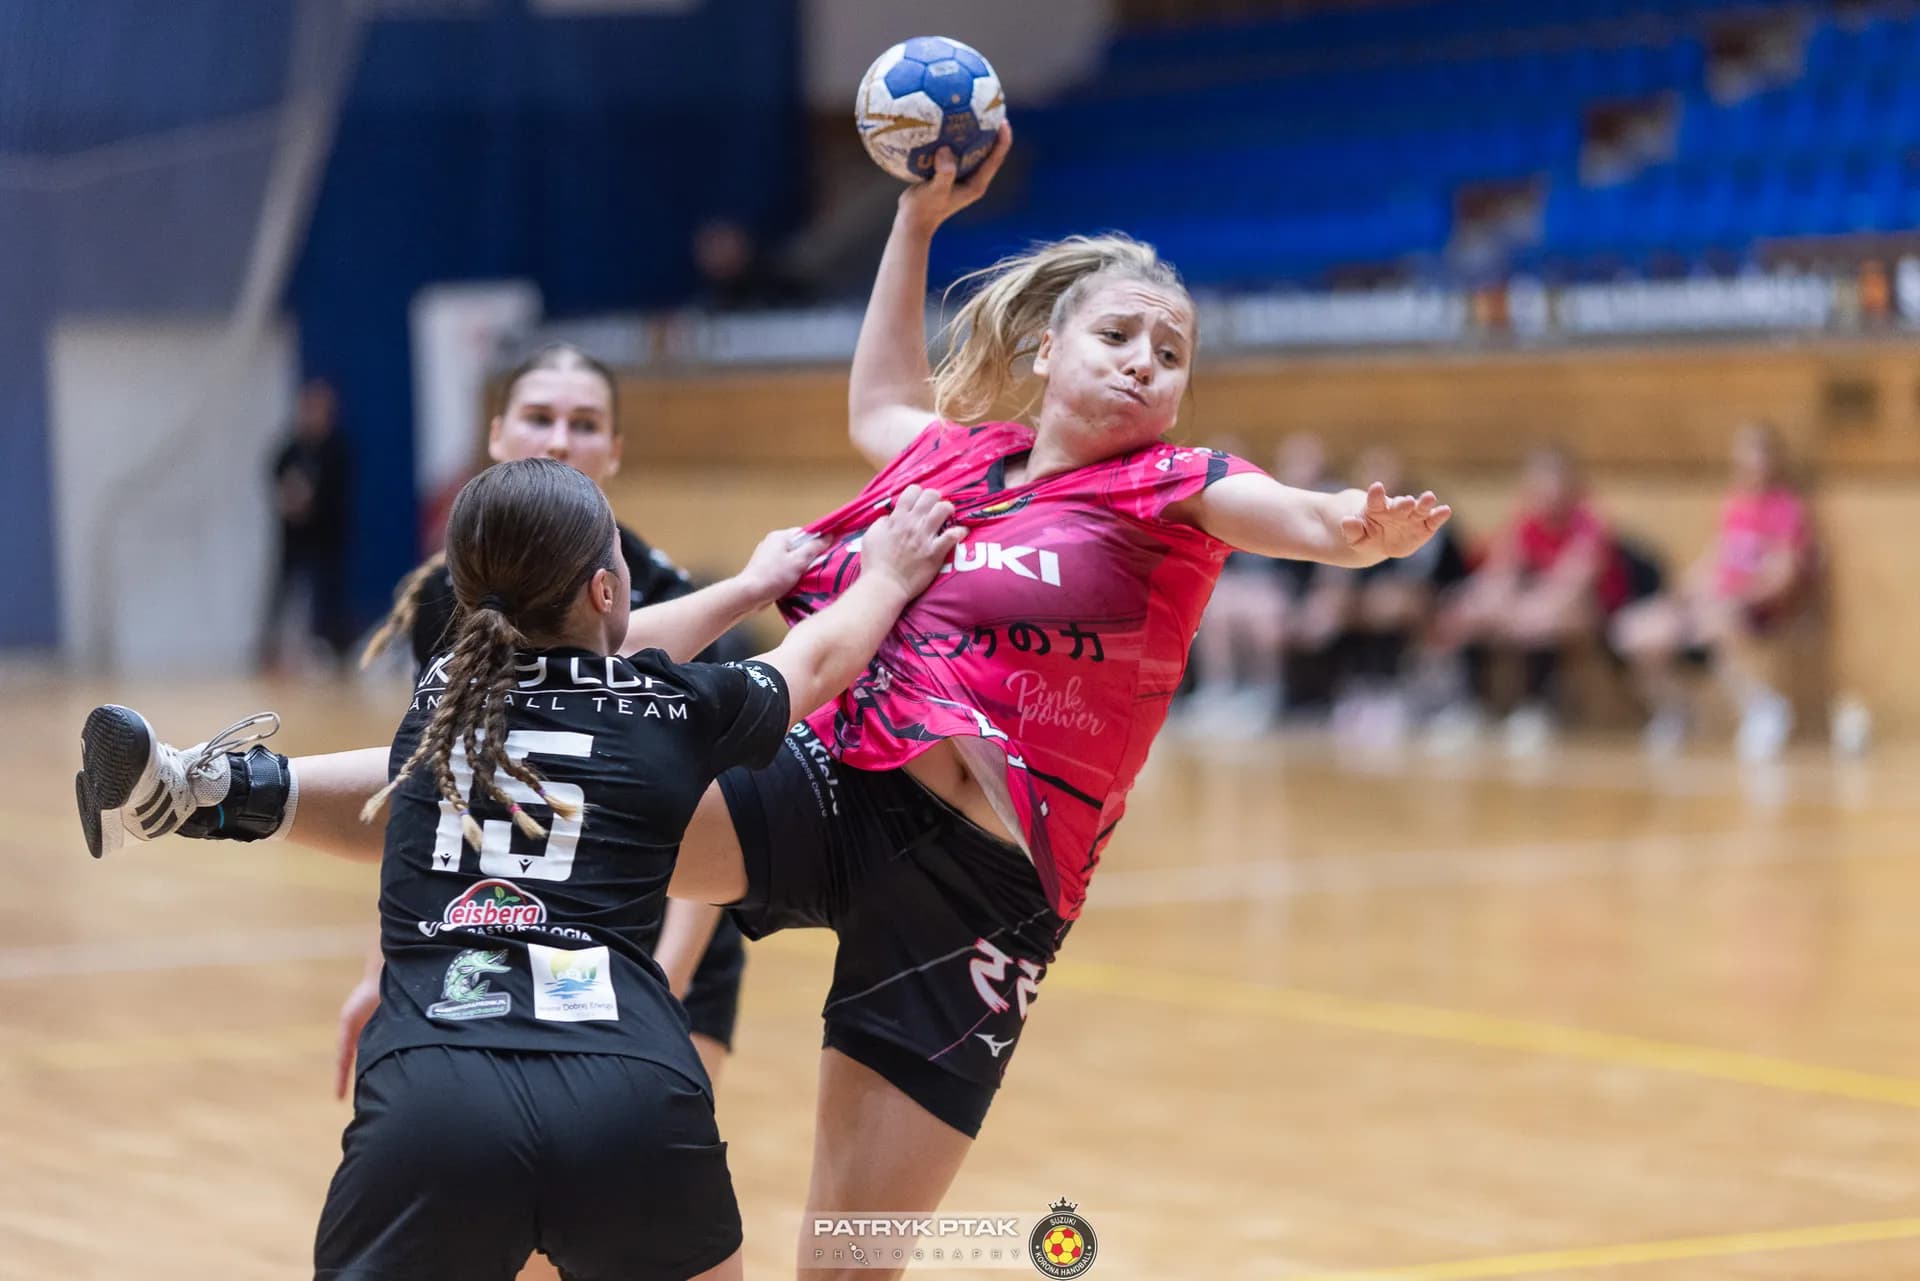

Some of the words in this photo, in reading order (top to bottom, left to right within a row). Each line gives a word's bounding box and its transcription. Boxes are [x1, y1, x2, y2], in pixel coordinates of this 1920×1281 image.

[592, 696, 688, 720] TEAM
[1006, 669, 1083, 712] Pink
[1018, 698, 1107, 738] power
[431, 729, 594, 882] 15
